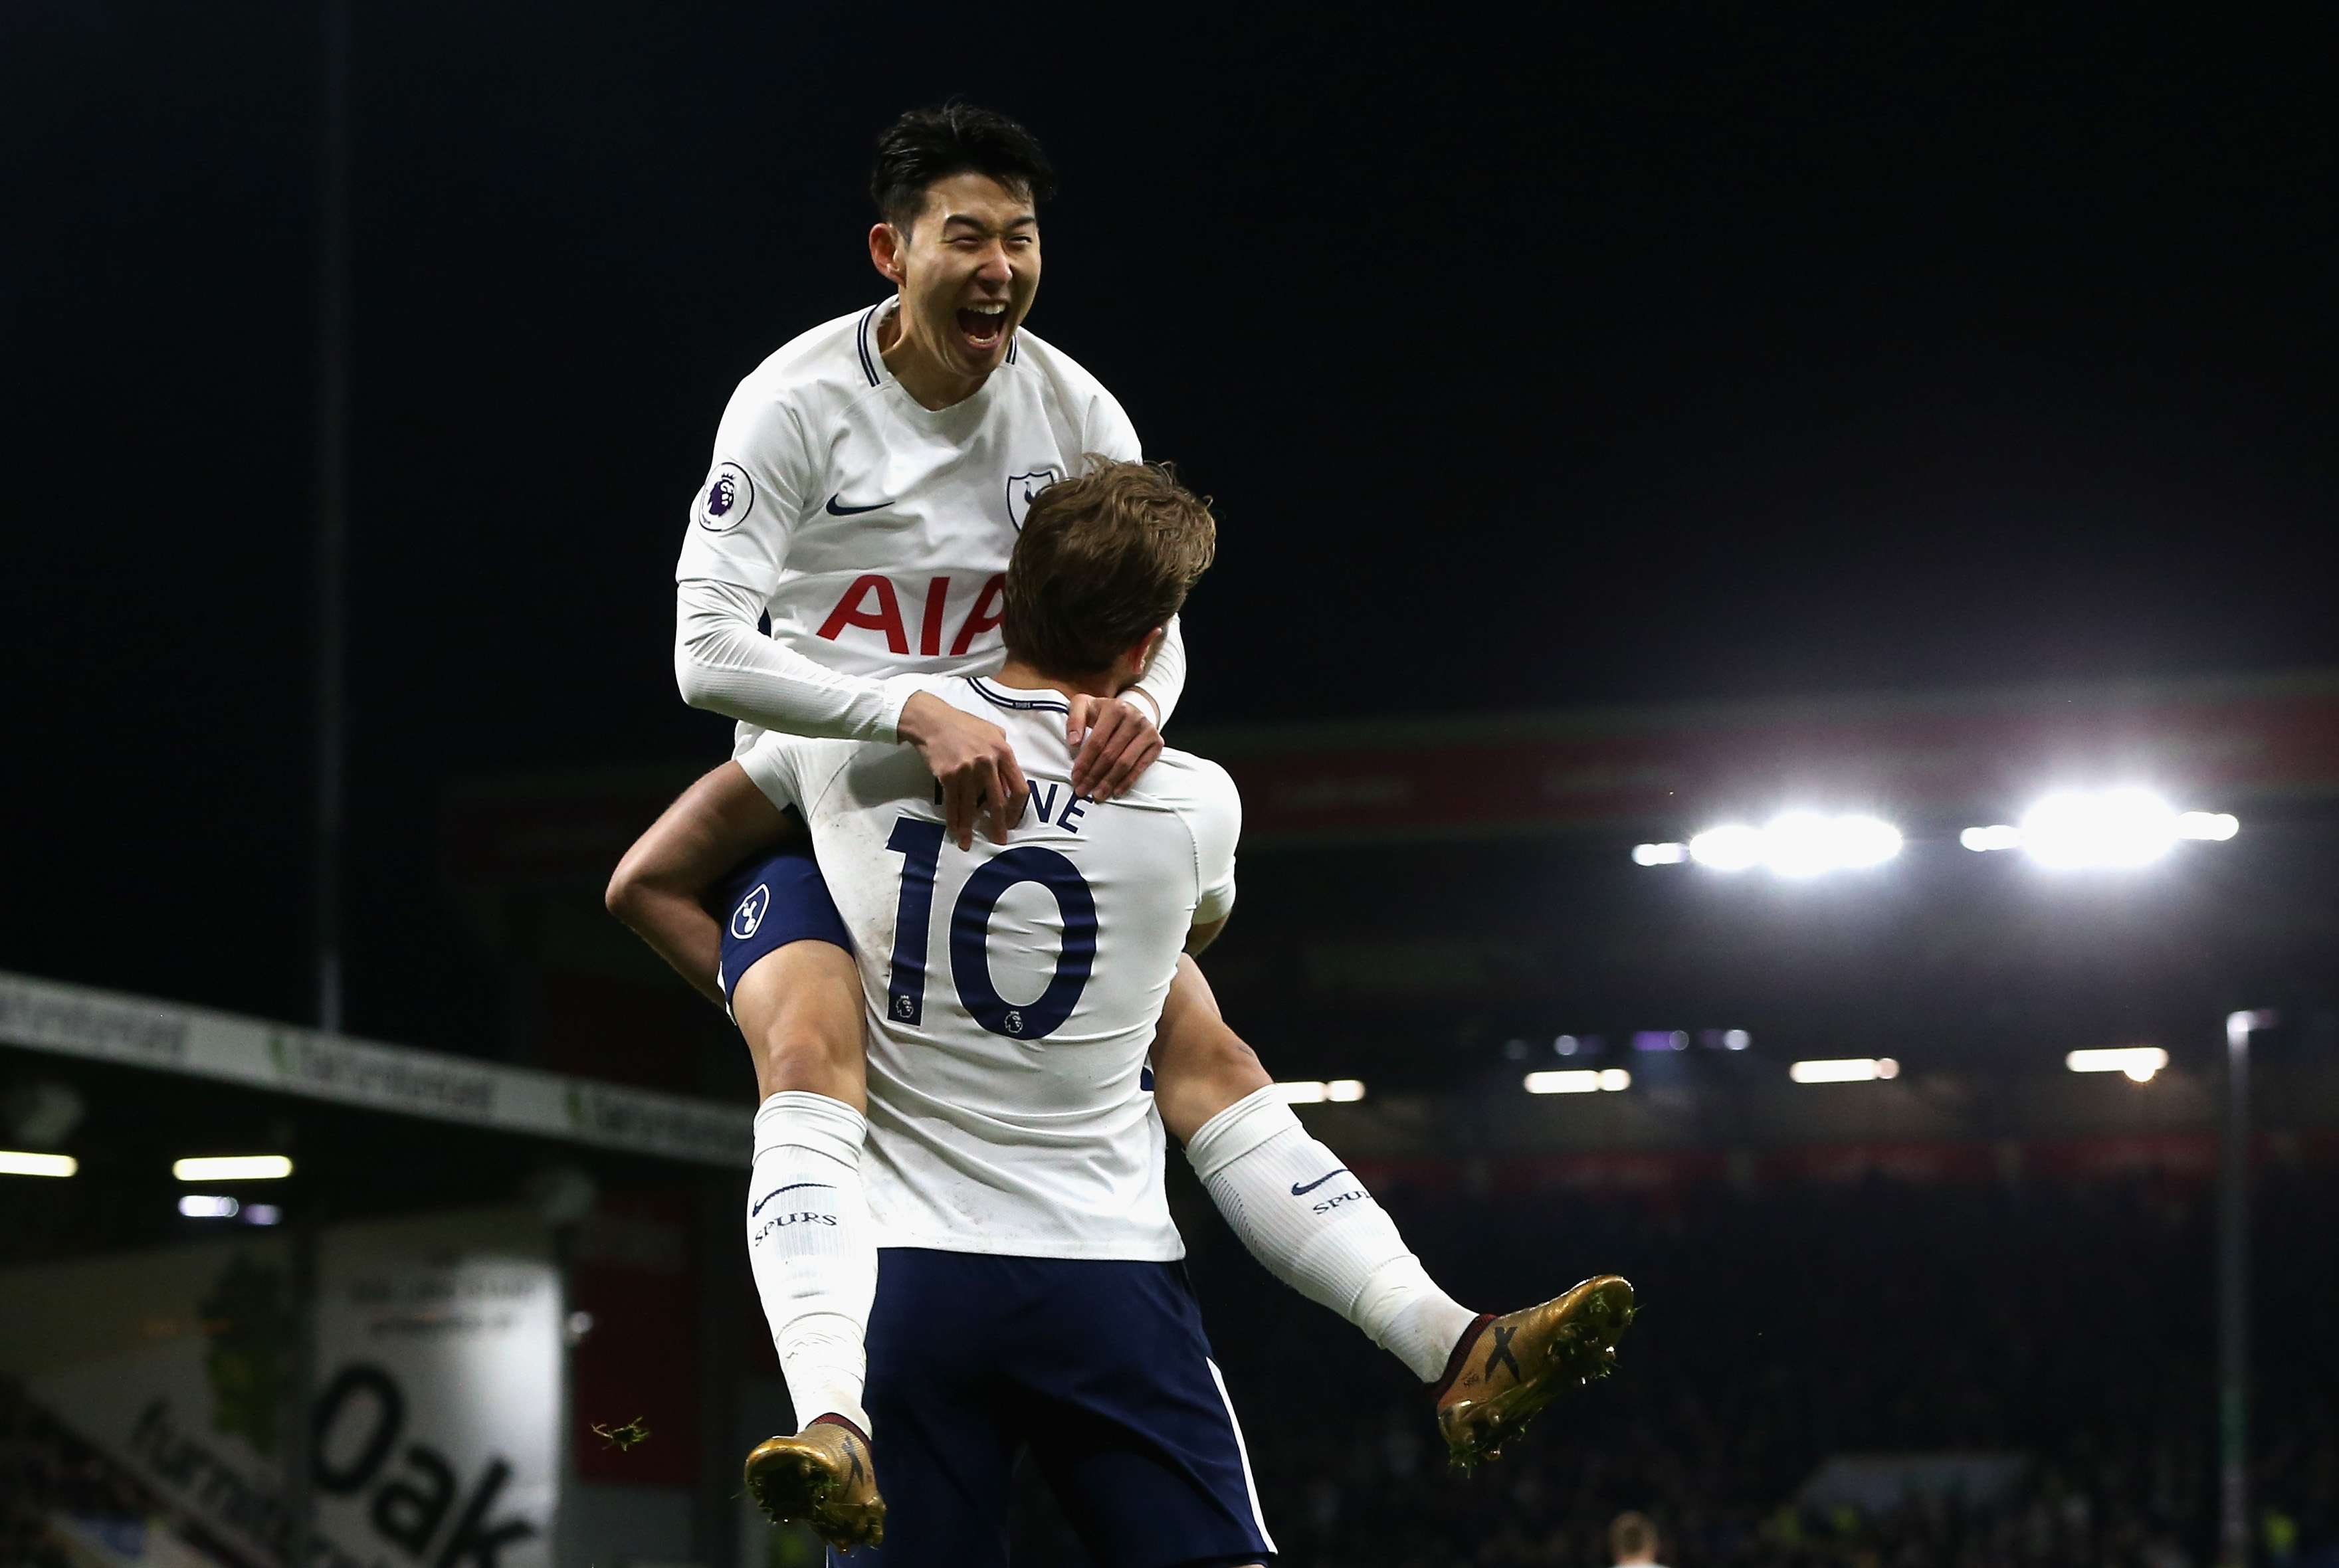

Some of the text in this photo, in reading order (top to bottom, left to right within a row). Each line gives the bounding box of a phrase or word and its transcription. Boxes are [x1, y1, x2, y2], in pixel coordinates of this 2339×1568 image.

[817, 573, 1009, 656] AIA
[934, 775, 1094, 834] NE
[885, 816, 1098, 1040] 10
[755, 1211, 837, 1247] SPURS
[312, 1364, 534, 1568] Oak
